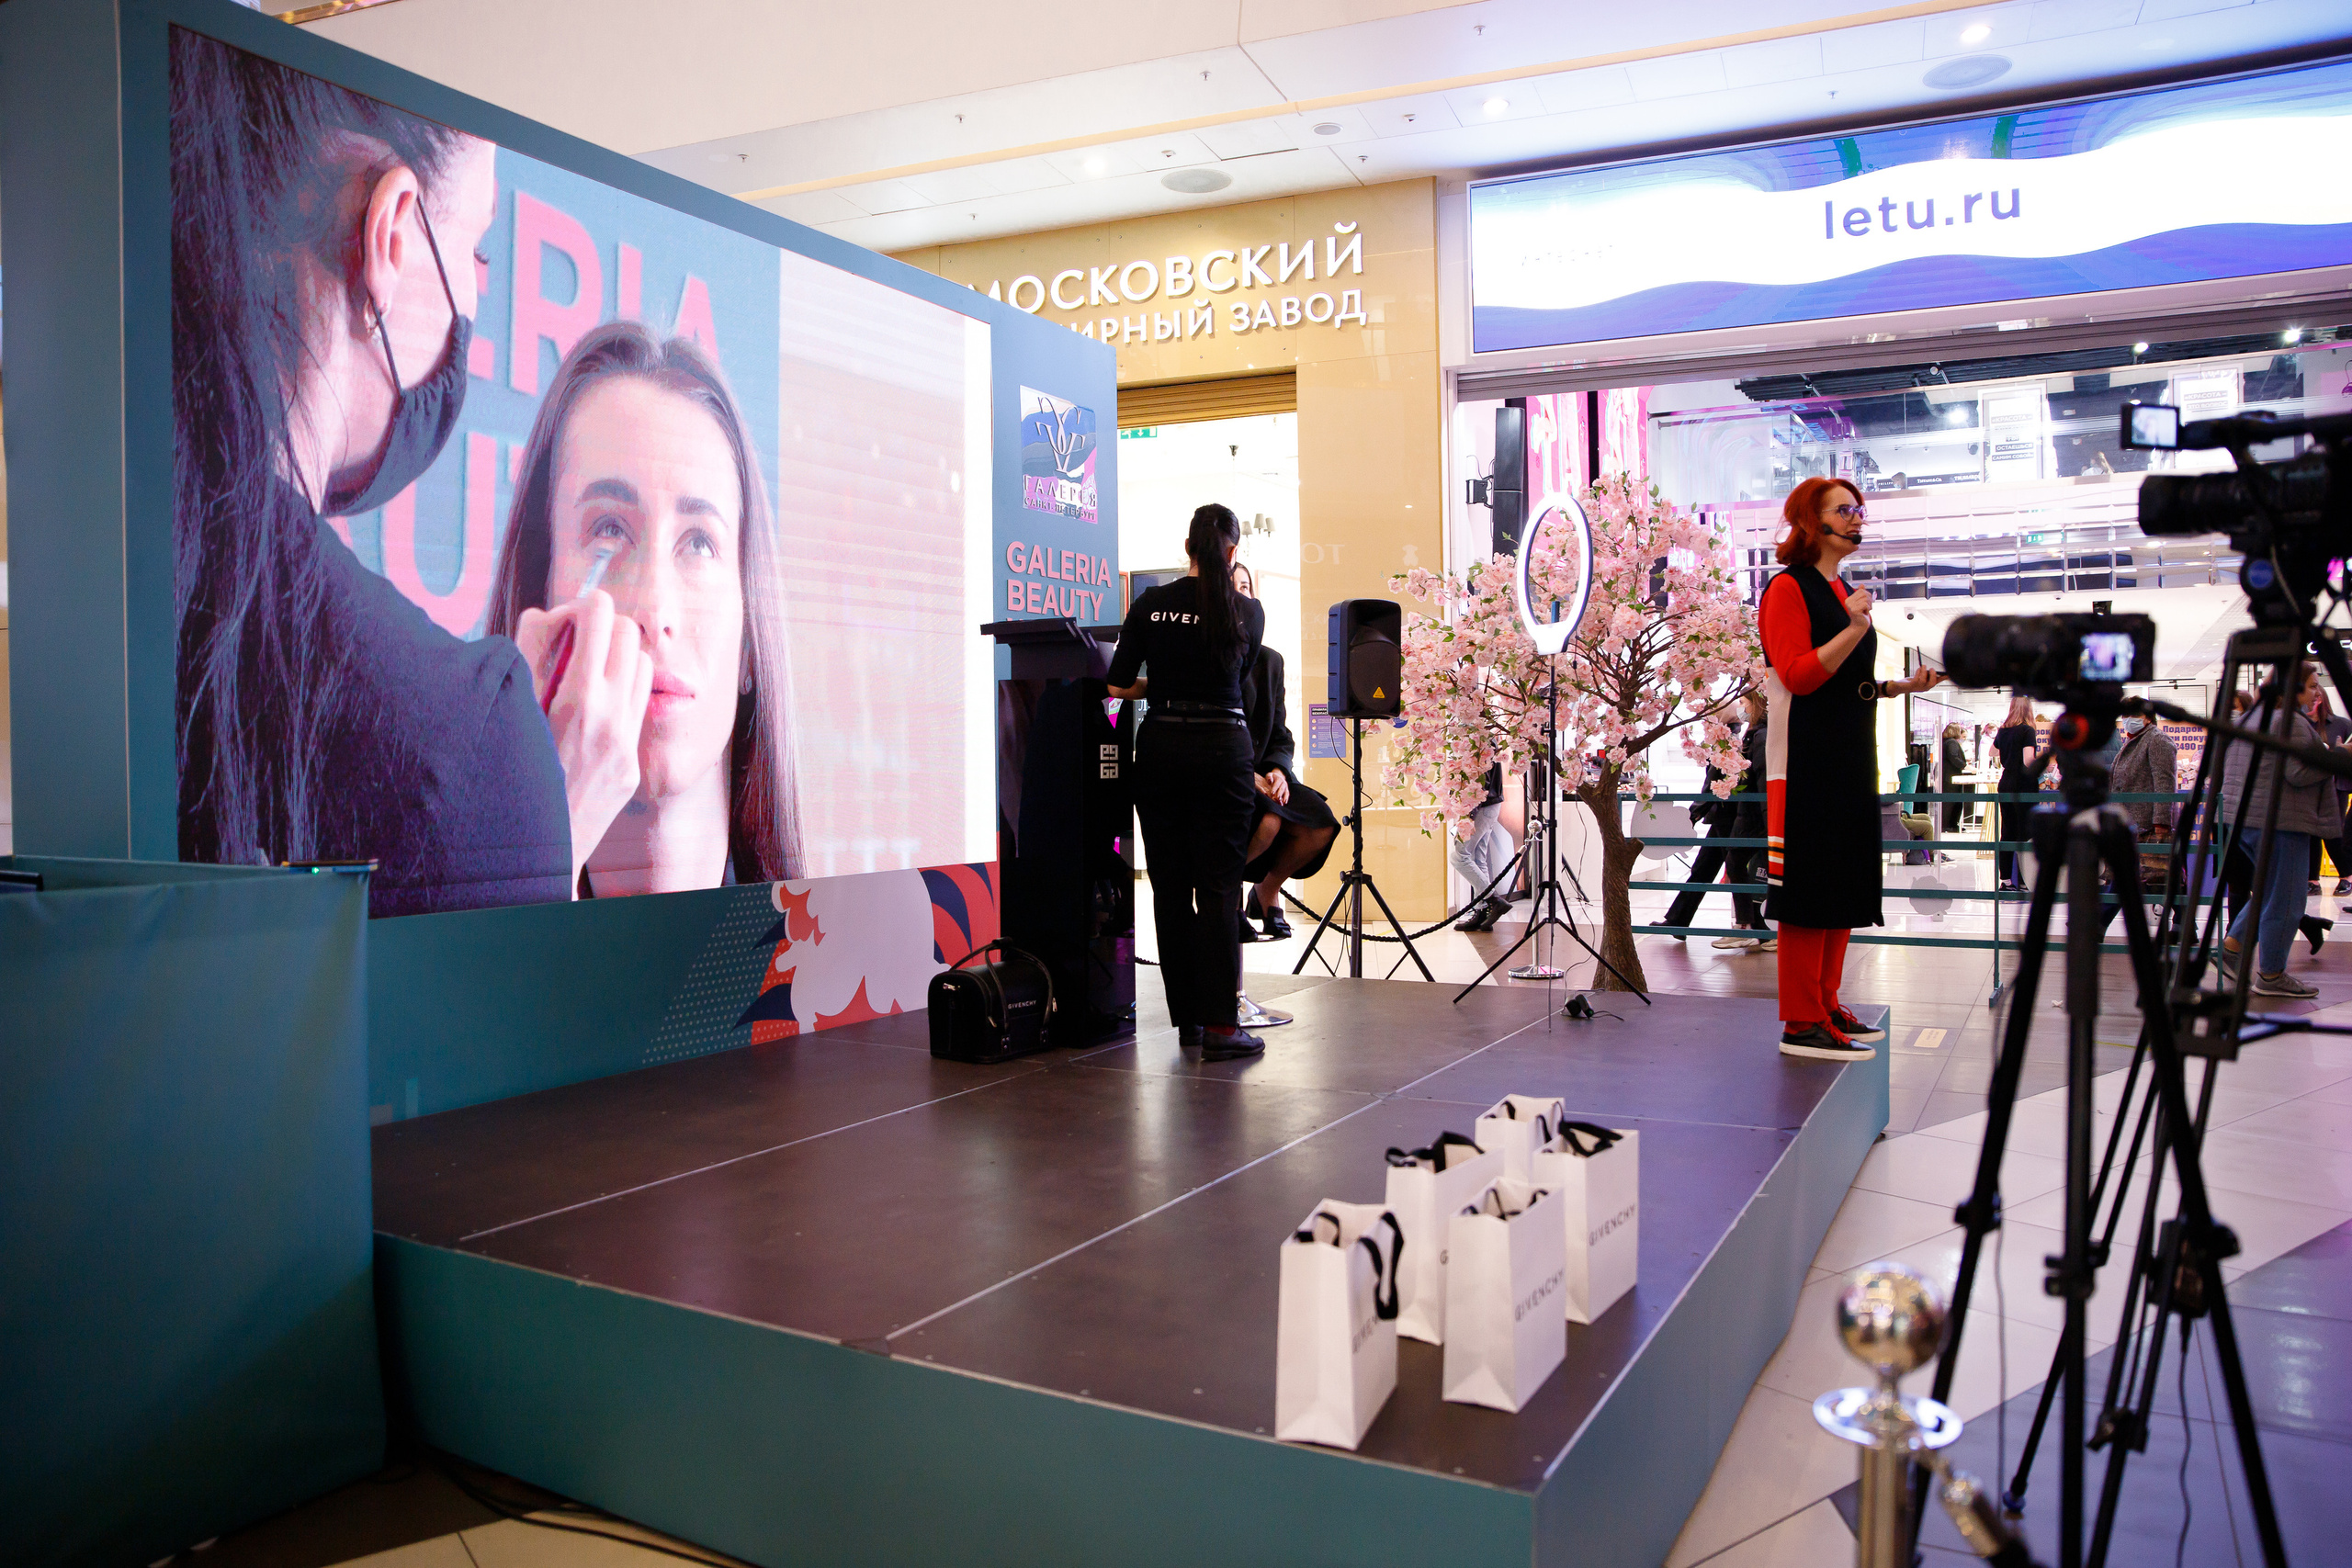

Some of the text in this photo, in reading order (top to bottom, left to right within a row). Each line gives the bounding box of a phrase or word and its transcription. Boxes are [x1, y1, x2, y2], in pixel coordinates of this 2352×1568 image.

[1825, 187, 2020, 240] letu.ru
[1229, 288, 1367, 334] ЗАВОД
[1023, 474, 1097, 507] ГАЛЕРЕЯ
[1006, 540, 1113, 589] GALERIA
[1006, 579, 1104, 622] BEAUTY
[2163, 726, 2203, 734] Подарок
[1007, 999, 1037, 1010] GIVENCHY
[1588, 1202, 1635, 1247] GIVENCHY
